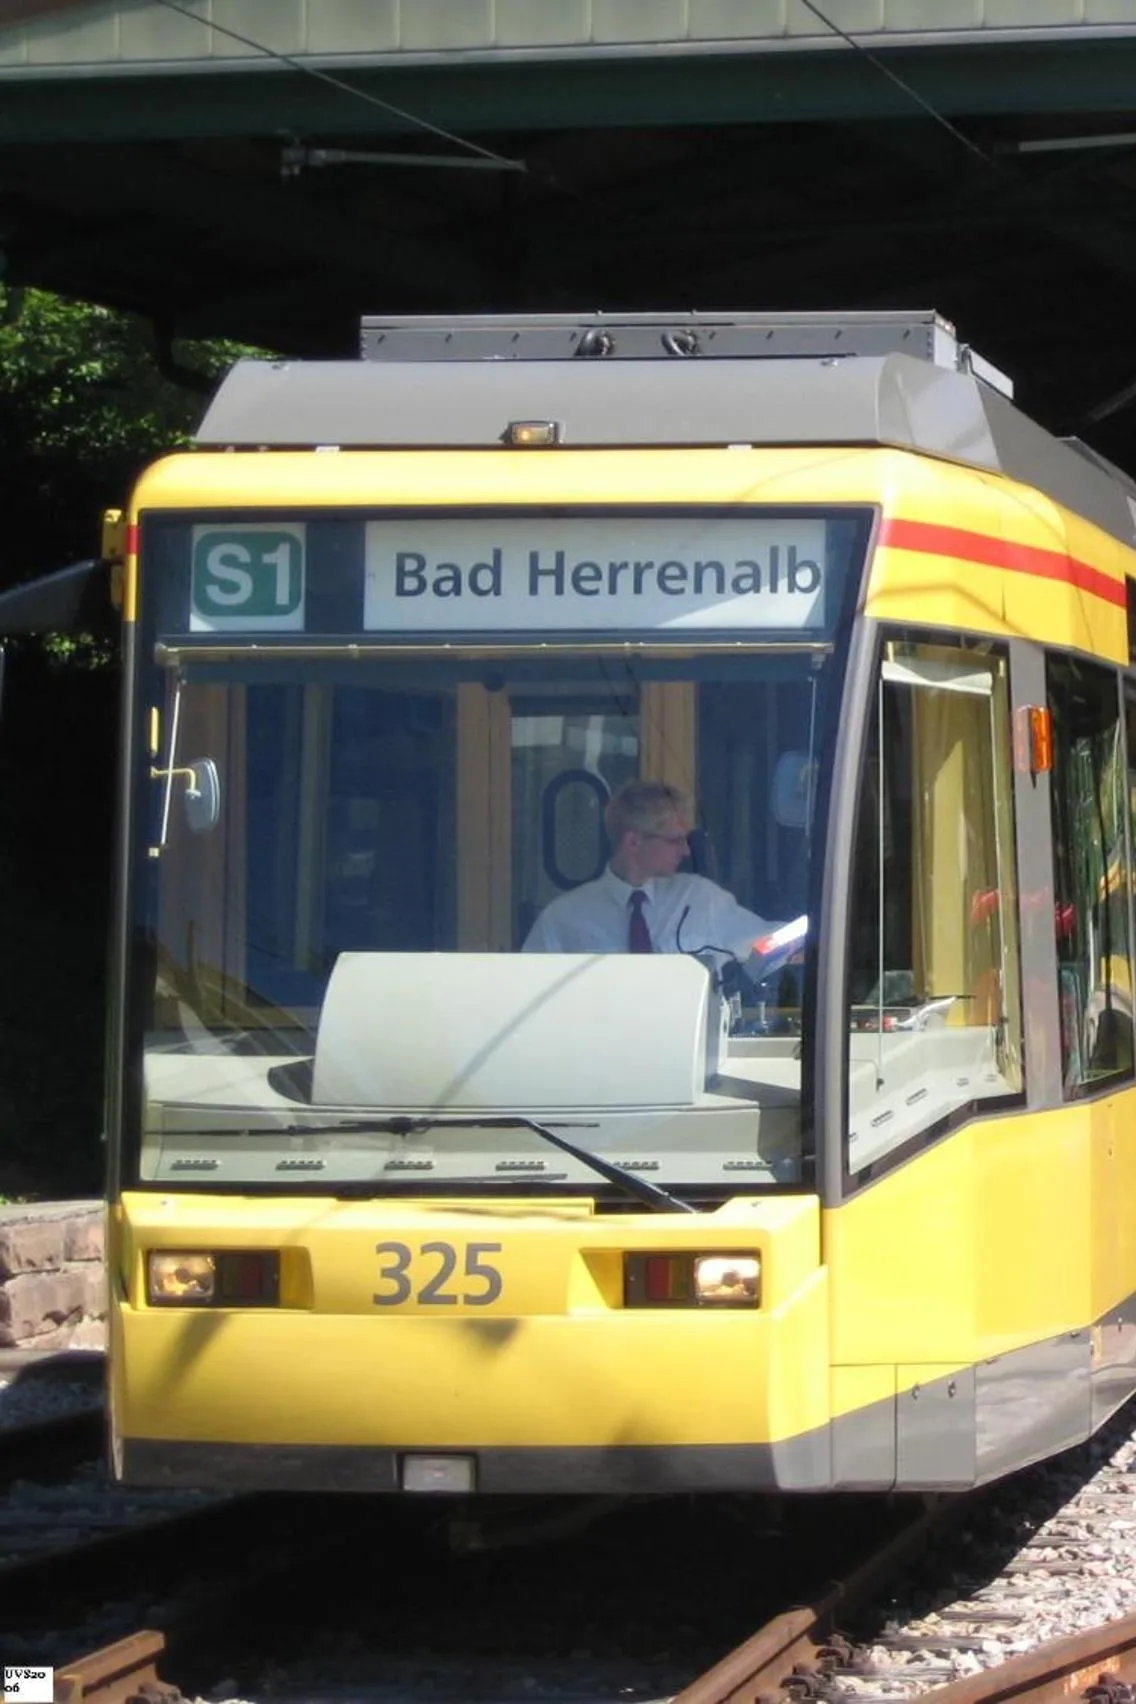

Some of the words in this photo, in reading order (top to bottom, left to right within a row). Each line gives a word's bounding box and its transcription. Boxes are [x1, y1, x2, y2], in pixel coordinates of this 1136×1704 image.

[206, 542, 291, 606] S1
[395, 548, 502, 597] Bad
[528, 545, 821, 596] Herrenalb
[373, 1241, 502, 1306] 325
